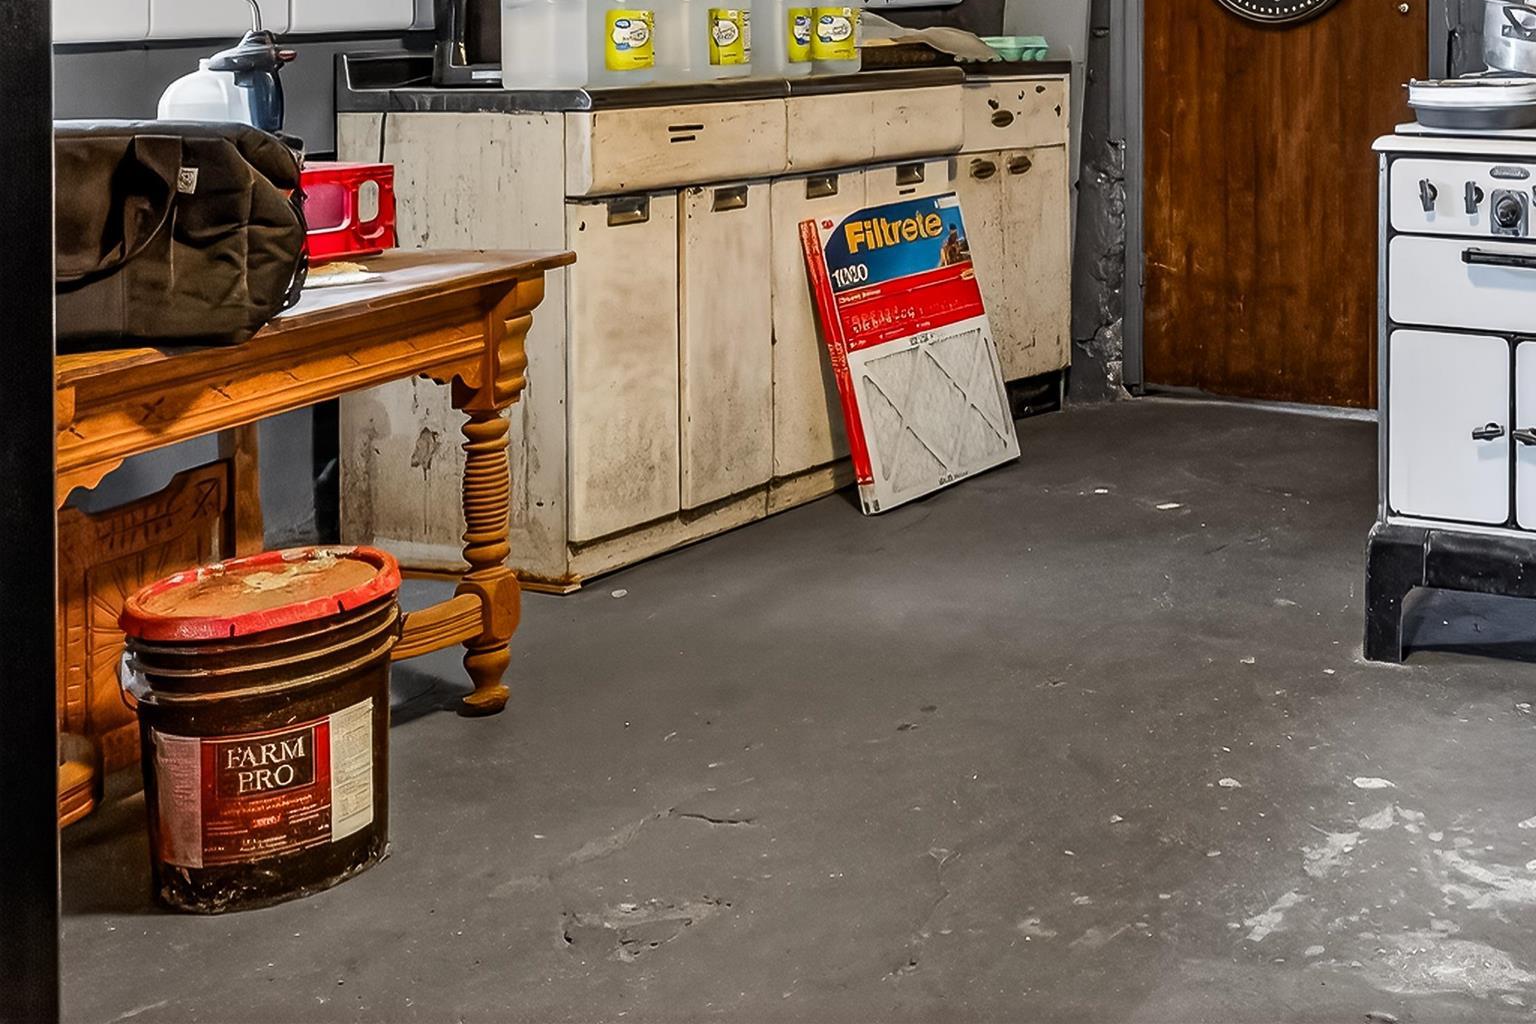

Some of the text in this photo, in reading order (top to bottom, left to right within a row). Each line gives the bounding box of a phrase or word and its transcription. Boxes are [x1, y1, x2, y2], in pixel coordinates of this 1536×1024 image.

[844, 210, 943, 254] Filtrete
[225, 736, 306, 770] FARM
[238, 764, 294, 793] PRO
